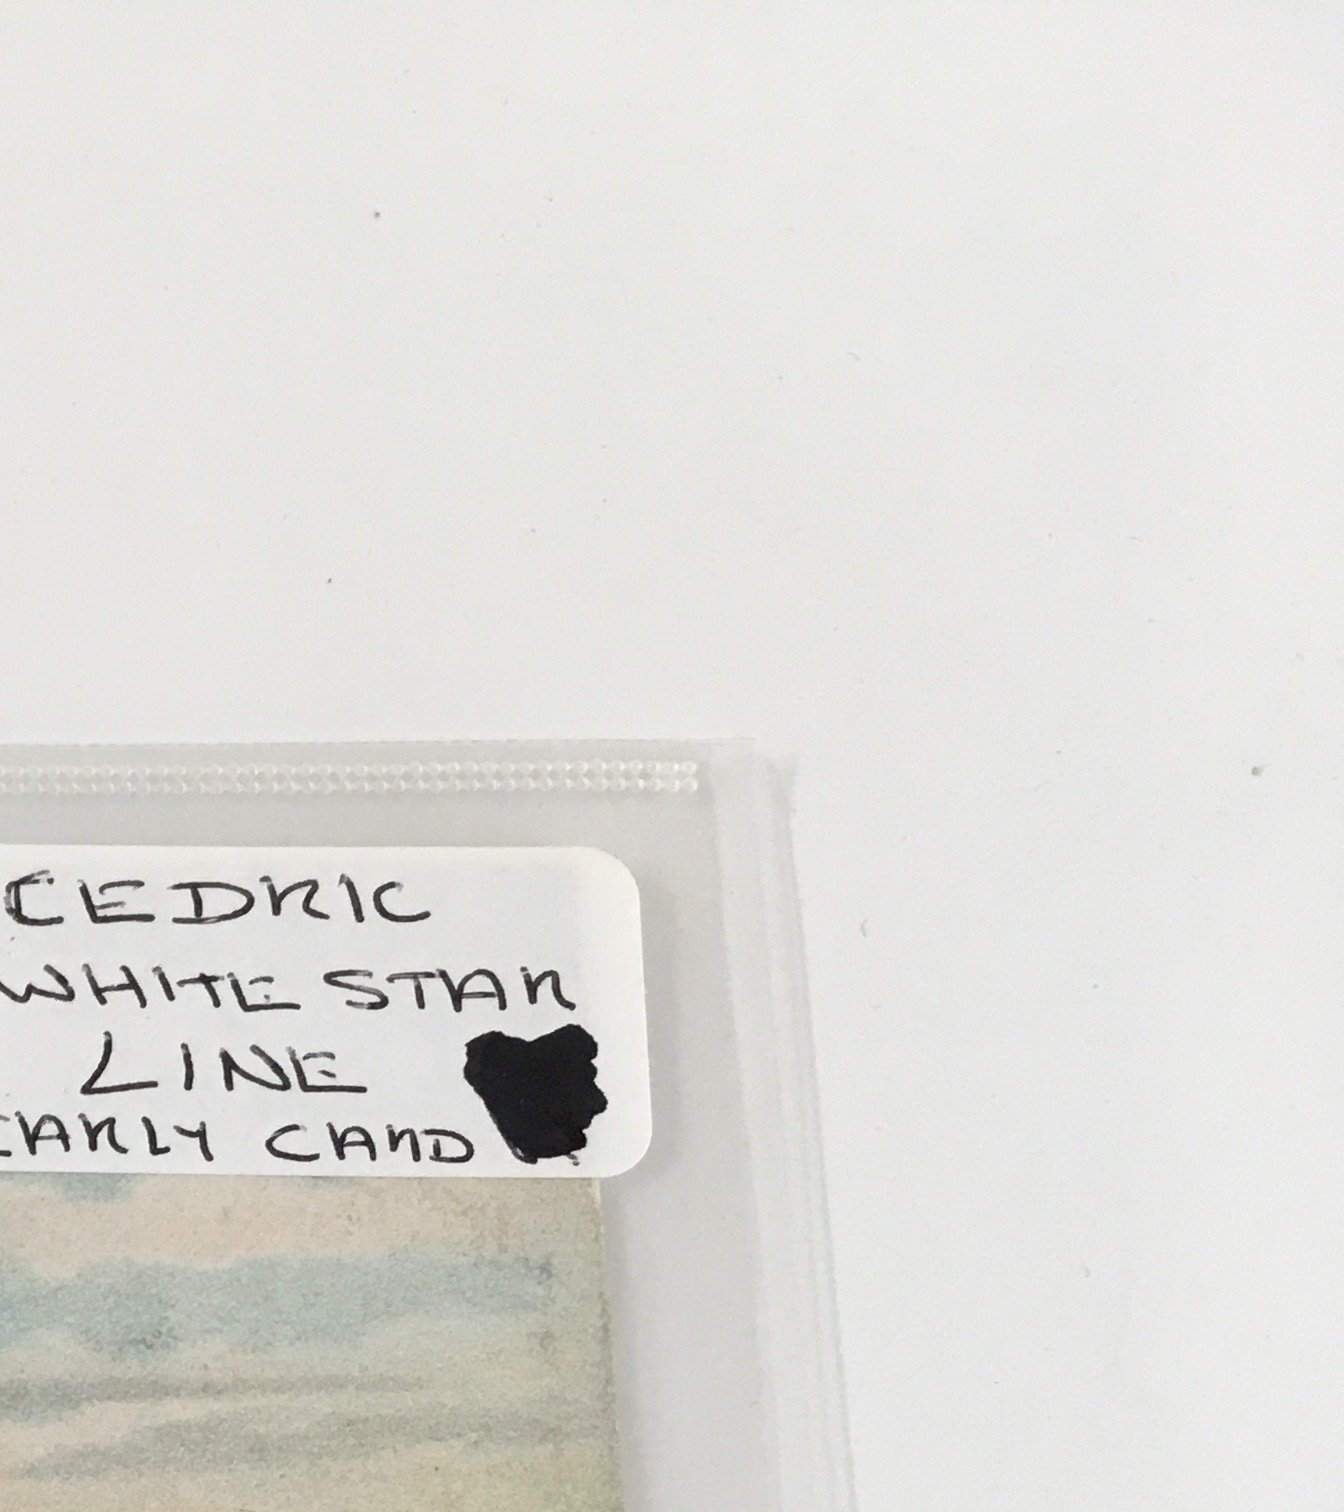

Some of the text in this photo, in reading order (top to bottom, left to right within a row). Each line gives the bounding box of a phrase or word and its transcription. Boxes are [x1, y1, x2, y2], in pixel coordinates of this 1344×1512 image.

[3, 870, 432, 926] CEDRIC
[322, 966, 578, 1013] STAR
[79, 1029, 368, 1095] LINE
[264, 1123, 476, 1165] CARD
